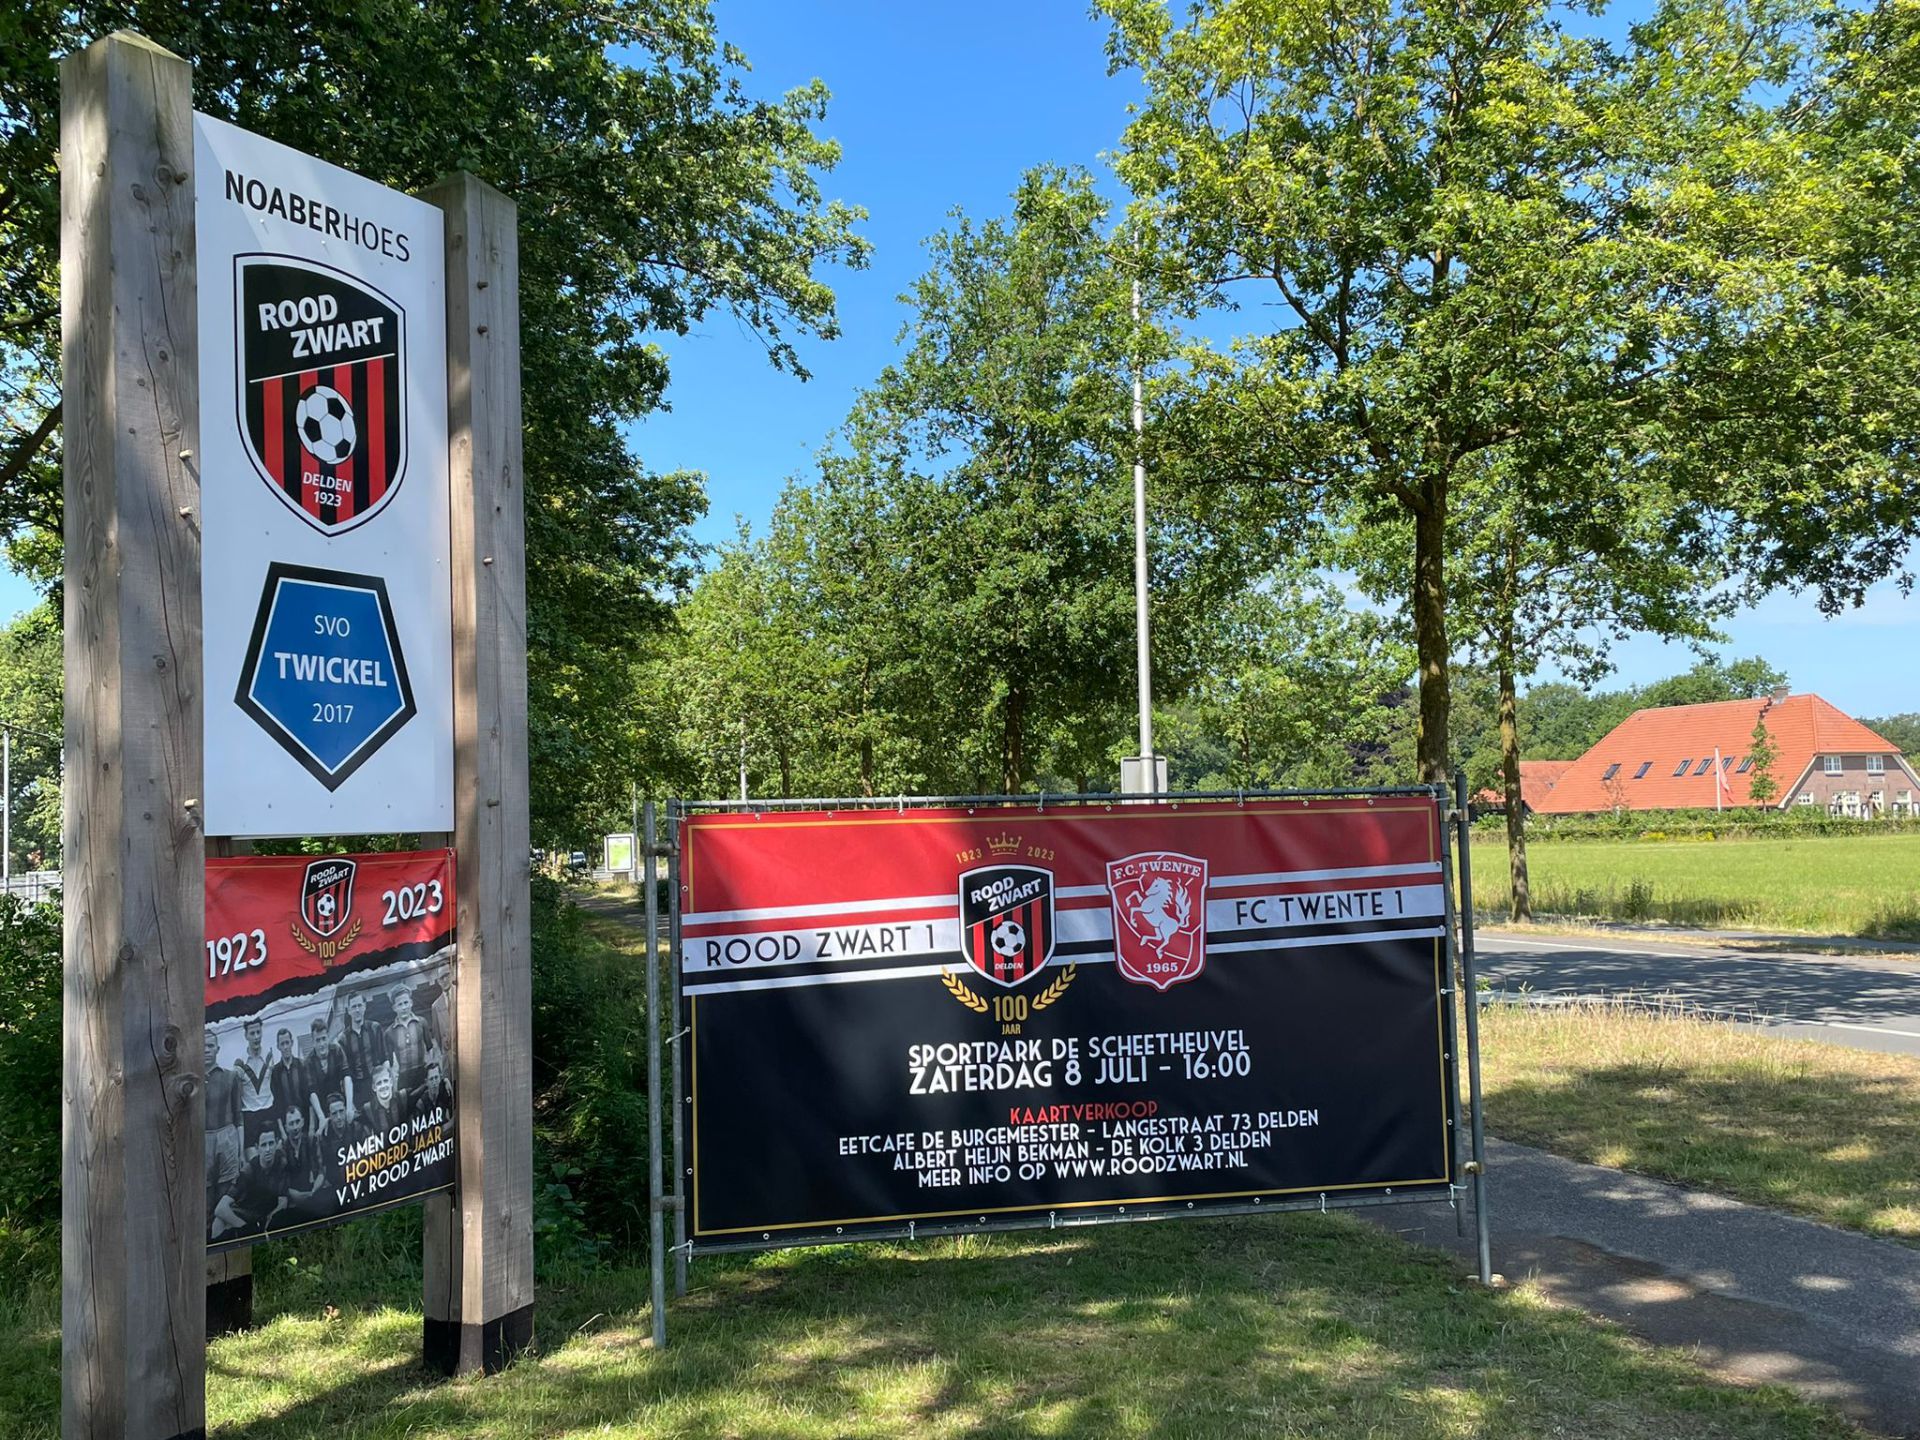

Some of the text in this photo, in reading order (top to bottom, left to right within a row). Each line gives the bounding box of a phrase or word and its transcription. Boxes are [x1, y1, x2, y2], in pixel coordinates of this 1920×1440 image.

[225, 169, 410, 262] NOABERHOES
[258, 294, 338, 331] ROOD
[290, 317, 385, 358] ZWART
[302, 471, 352, 493] DELDEN
[313, 491, 342, 507] 1923
[314, 615, 350, 637] SVO
[274, 652, 387, 687] TWICKEL
[312, 703, 353, 723] 2017
[956, 848, 982, 864] 1923
[1027, 846, 1054, 861] 2023
[1113, 861, 1201, 880] F.C. TWENTE
[310, 866, 336, 884] ROOD
[318, 867, 349, 888] ZWART
[971, 876, 1014, 904] ROOD
[382, 879, 443, 926] 2023
[988, 878, 1042, 912] ZWART
[1236, 890, 1403, 925] FC TWENTE 1
[207, 928, 267, 978] 1923
[318, 941, 335, 957] 100
[706, 924, 934, 966] ROOD ZWART 1
[995, 962, 1023, 970] DELDEN
[1146, 962, 1178, 974] 1965
[993, 995, 1028, 1021] 100
[1002, 1024, 1021, 1035] JAAR
[909, 1029, 1249, 1067] SPORTPARK DE SCHEETHEUVEL
[909, 1061, 1052, 1094] ZATERDAG
[1064, 1060, 1082, 1086] 8
[1095, 1056, 1147, 1085] JULI
[1183, 1052, 1251, 1079] 16:00
[1010, 1101, 1158, 1125] KAARTVERKOOP
[337, 1107, 443, 1166] SAMEN OP NAAR
[839, 1133, 914, 1155] EETCAFE
[922, 1131, 944, 1149] DE
[952, 1123, 1079, 1147] BURGEMEESTER
[1103, 1115, 1223, 1139] LANGESTRAAT
[1231, 1114, 1251, 1130] 73
[1258, 1109, 1318, 1129] DELDEN
[346, 1126, 442, 1183] HONDERD JAAR
[894, 1149, 957, 1171] ALBERT
[965, 1146, 1010, 1165] HEIJN
[1018, 1141, 1089, 1162] BEKMAN
[1112, 1139, 1133, 1156] DE
[1140, 1135, 1185, 1155] KOLK
[1194, 1135, 1202, 1151] 3
[1210, 1131, 1271, 1150] DELDEN
[336, 1138, 454, 1206] V.V. ROOD ZWART!
[919, 1151, 1248, 1187] MEER INFO OP WWW.ROODZWART.NL
